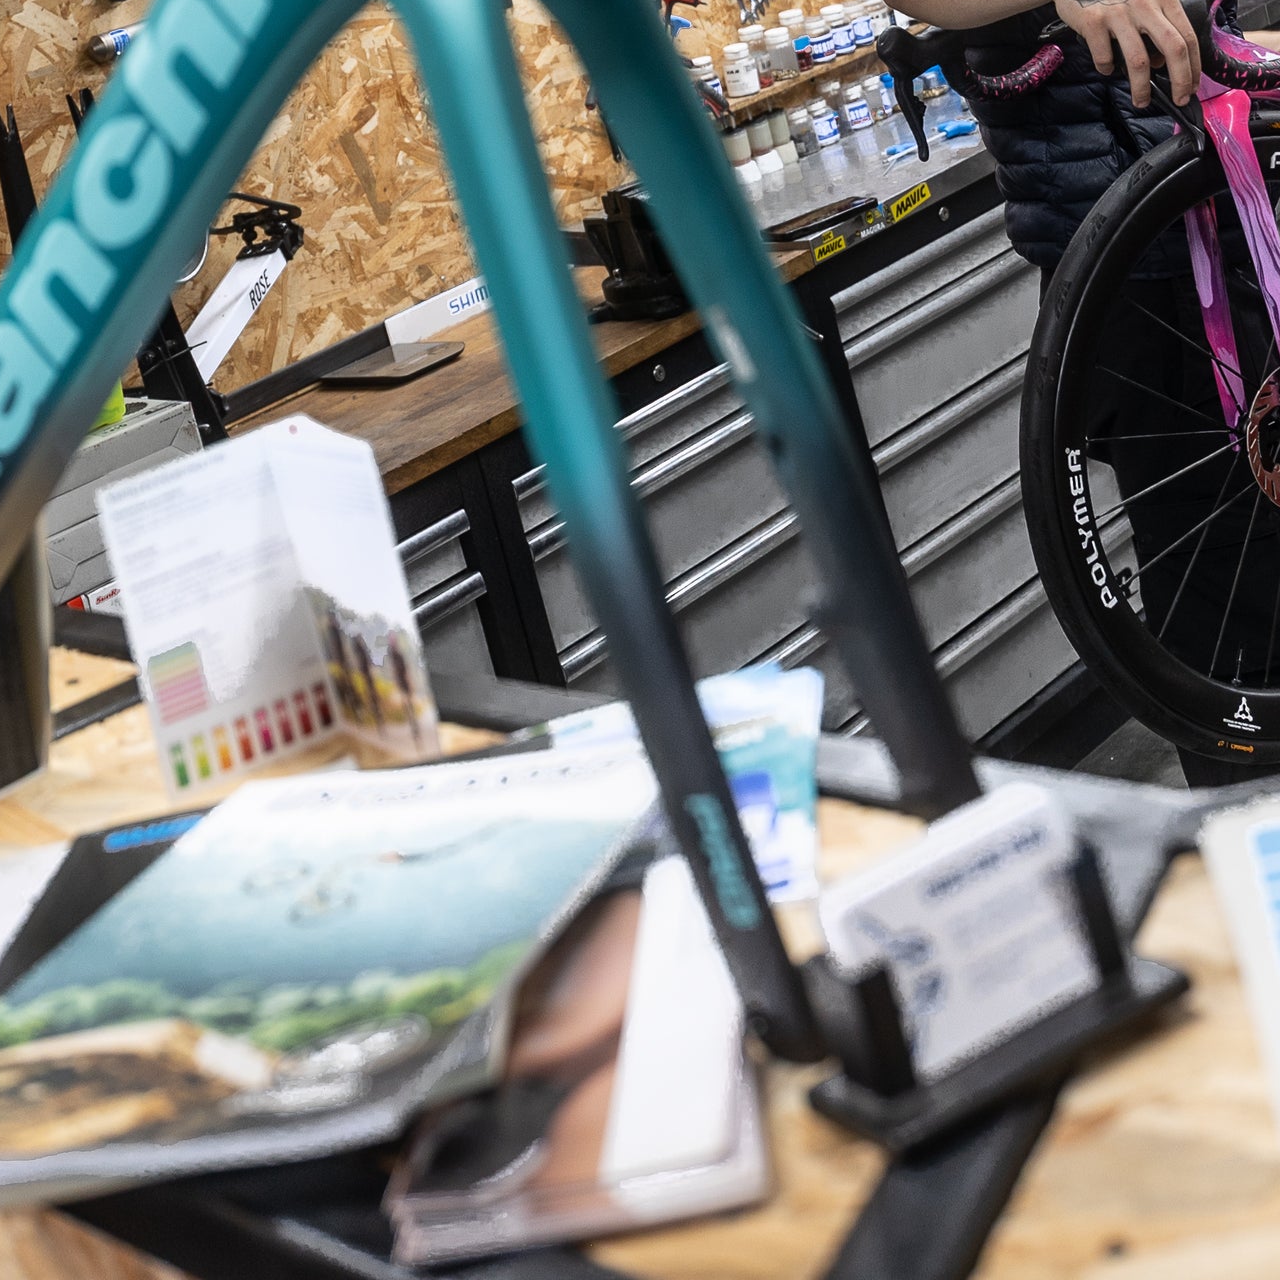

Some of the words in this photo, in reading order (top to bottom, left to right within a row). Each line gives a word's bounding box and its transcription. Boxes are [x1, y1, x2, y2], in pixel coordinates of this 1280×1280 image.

[895, 183, 928, 217] MAVIC
[817, 237, 845, 260] MAVIC
[249, 269, 272, 310] ROSE
[1065, 448, 1118, 609] POLYMER
